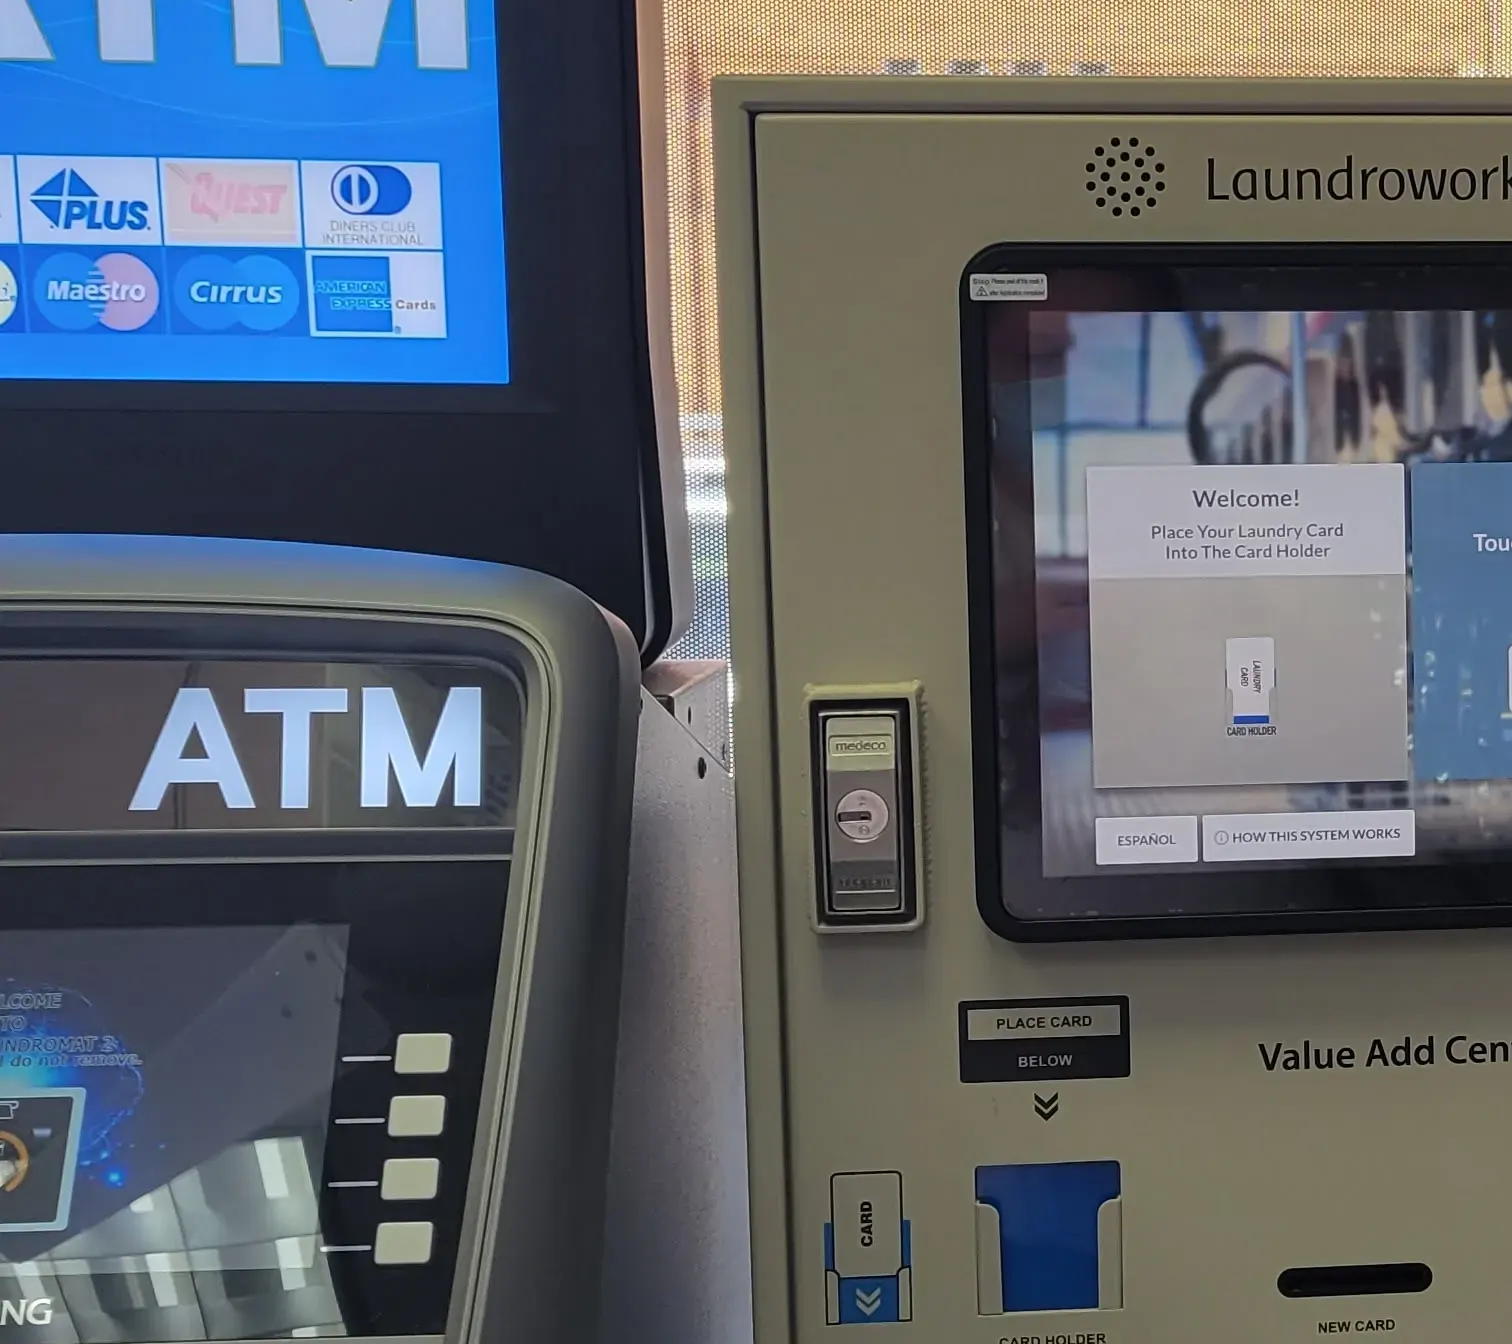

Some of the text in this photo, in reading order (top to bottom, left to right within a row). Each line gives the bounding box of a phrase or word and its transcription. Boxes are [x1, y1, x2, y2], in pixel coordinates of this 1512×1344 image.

[64, 200, 149, 231] PLUS
[330, 220, 416, 233] DINERS CLUB
[322, 233, 425, 246] INTERNATIONAL
[48, 280, 147, 302] Maestro
[189, 281, 284, 304] Cirrus
[315, 281, 387, 293] AMERICAN
[331, 298, 436, 310] EXPRESS Cards
[1192, 489, 1300, 508] Welcome!
[1151, 523, 1344, 541] Place Your Laundry Card
[1165, 544, 1331, 560] Into The Card Holder
[1241, 667, 1249, 687] CARD
[1253, 660, 1262, 693] LAUNDRY
[1227, 726, 1277, 736] CARD HOLDER
[128, 687, 482, 811] ATM
[835, 739, 886, 751] medeco
[1117, 832, 1177, 847] ESPAÑOL
[1232, 828, 1401, 844] HOW THIS SYSTEM WORKS
[996, 1015, 1092, 1030] PLACE CARD
[10, 1056, 32, 1067] do
[38, 1054, 68, 1067] not
[1018, 1054, 1073, 1068] BELOW
[1258, 1039, 1355, 1071] Value
[1365, 1035, 1436, 1068] Add
[860, 1200, 874, 1247] CARD
[1317, 1319, 1396, 1334] NEW CARD
